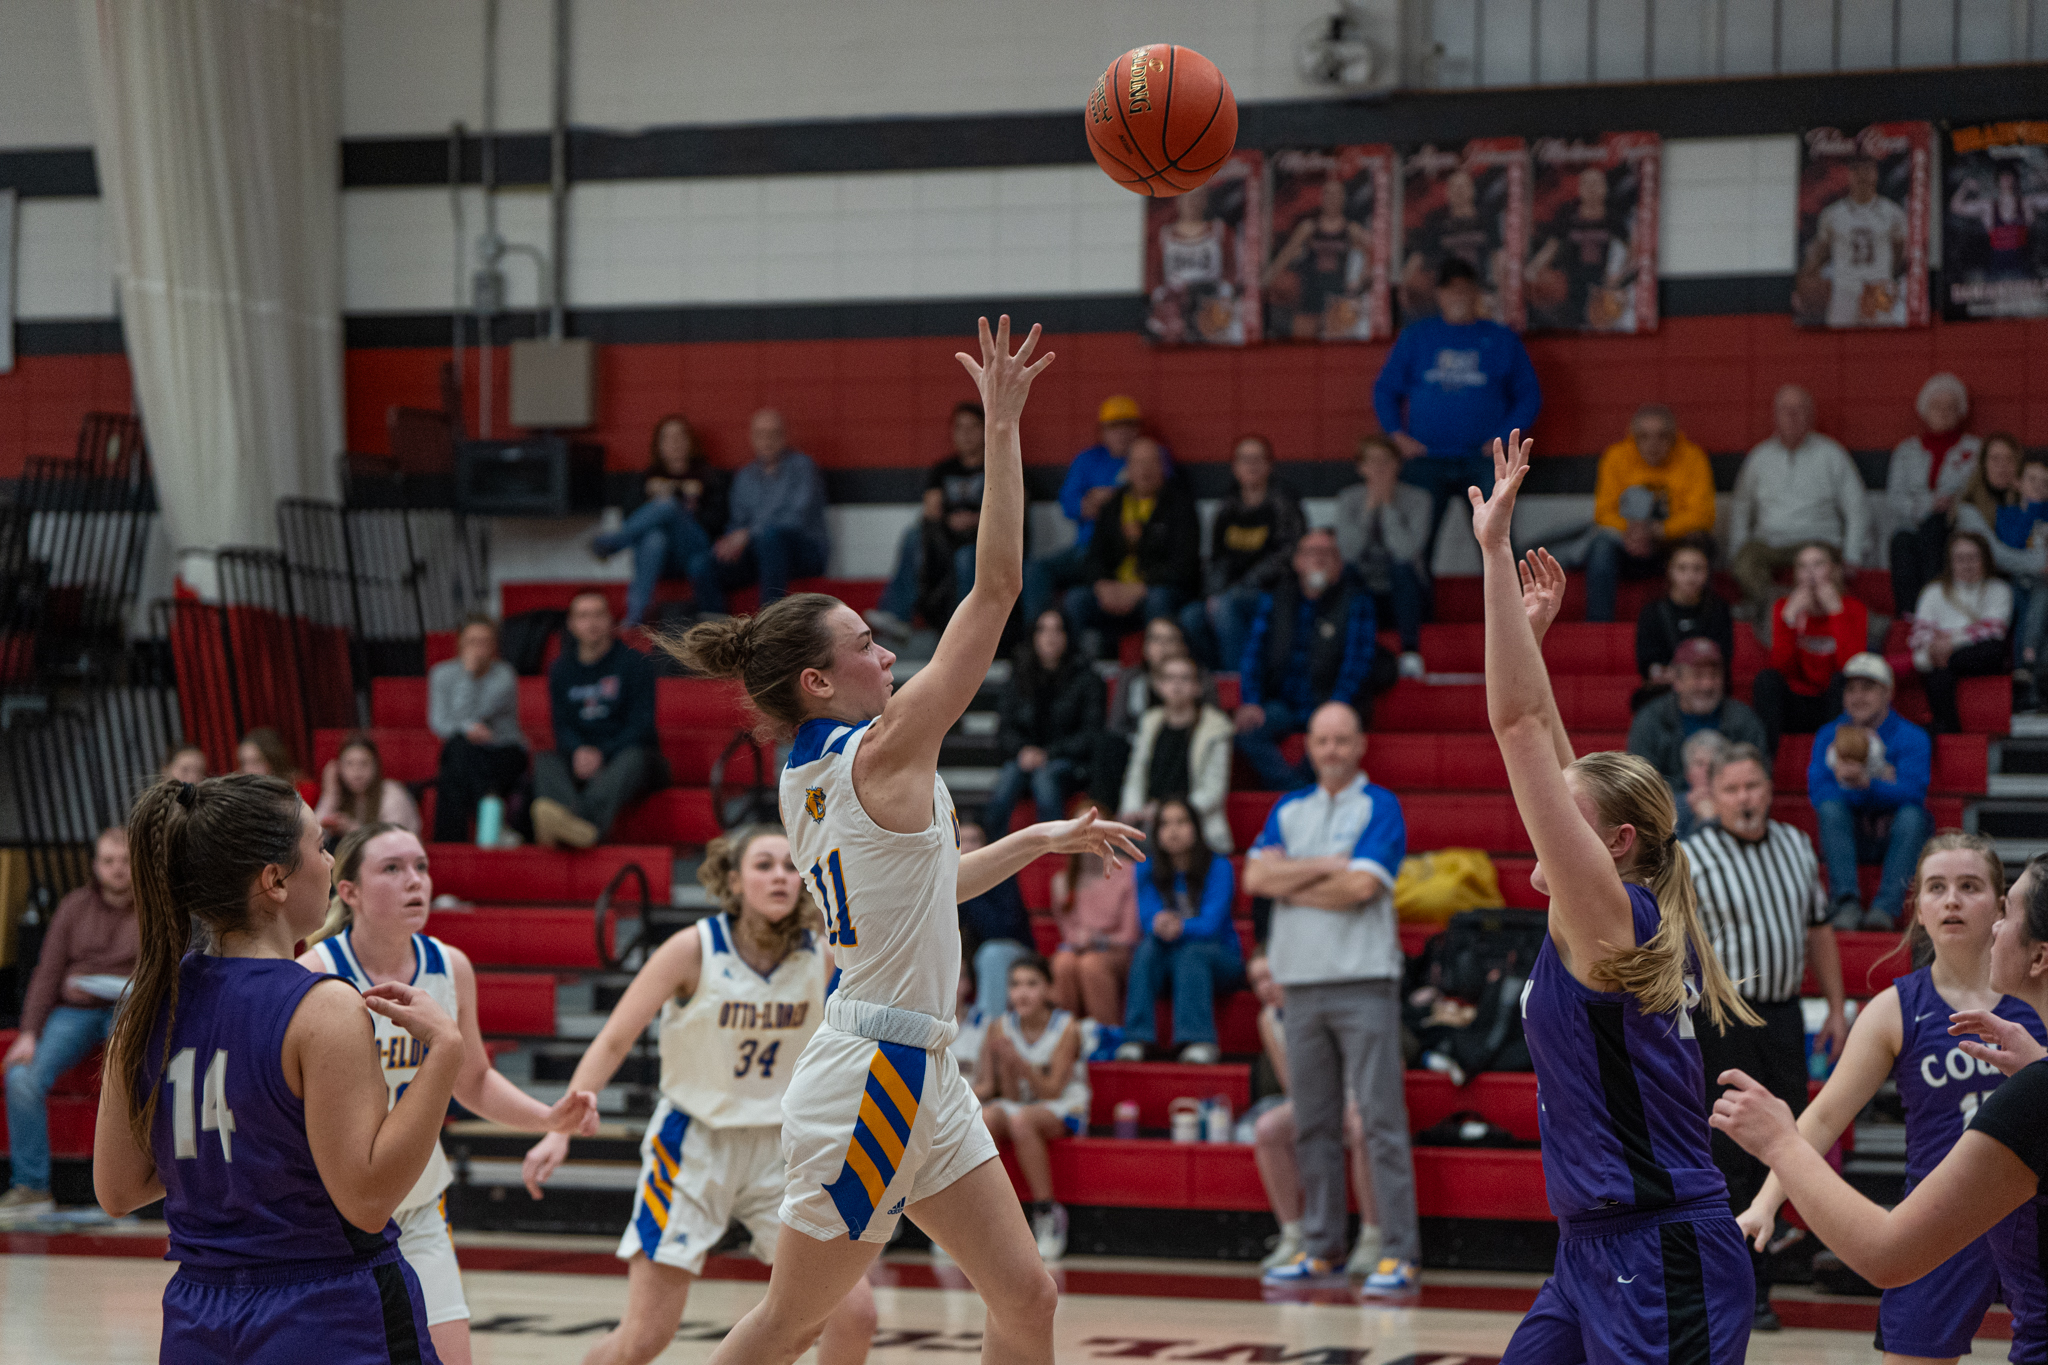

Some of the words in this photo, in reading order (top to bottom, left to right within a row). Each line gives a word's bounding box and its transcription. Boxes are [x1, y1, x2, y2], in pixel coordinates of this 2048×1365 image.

[1096, 70, 1113, 123] ACY
[1128, 45, 1153, 115] ALDING
[810, 847, 859, 948] 11
[733, 1038, 781, 1078] 34
[1920, 1042, 2002, 1089] COU
[166, 1046, 236, 1163] 14
[1958, 1088, 1996, 1131] 1
